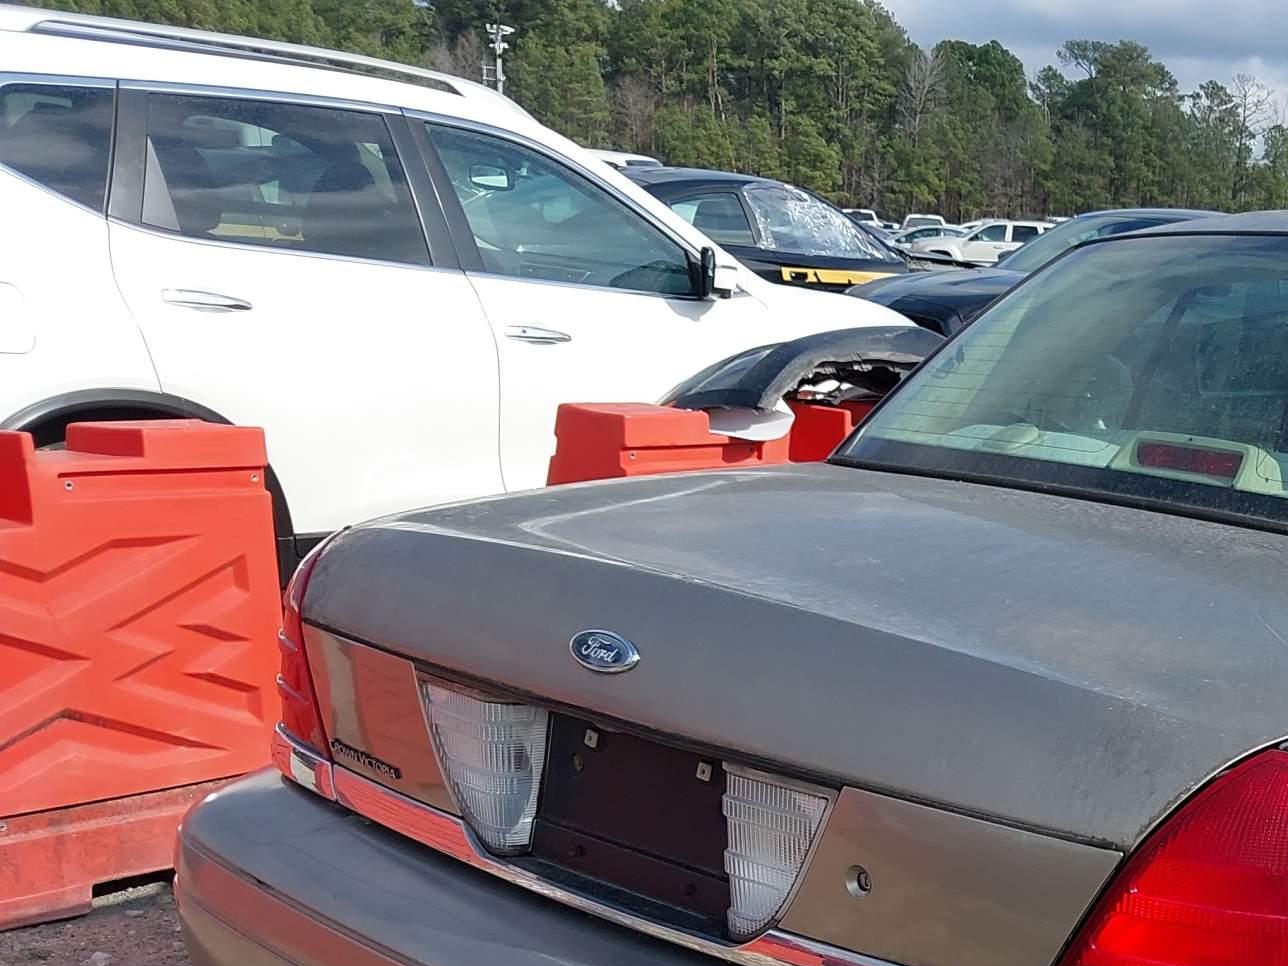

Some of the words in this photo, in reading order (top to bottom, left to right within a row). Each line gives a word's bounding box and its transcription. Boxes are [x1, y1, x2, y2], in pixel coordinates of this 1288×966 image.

[581, 635, 618, 663] Ford
[329, 739, 357, 761] CROWN
[358, 753, 396, 779] VICTORIA
